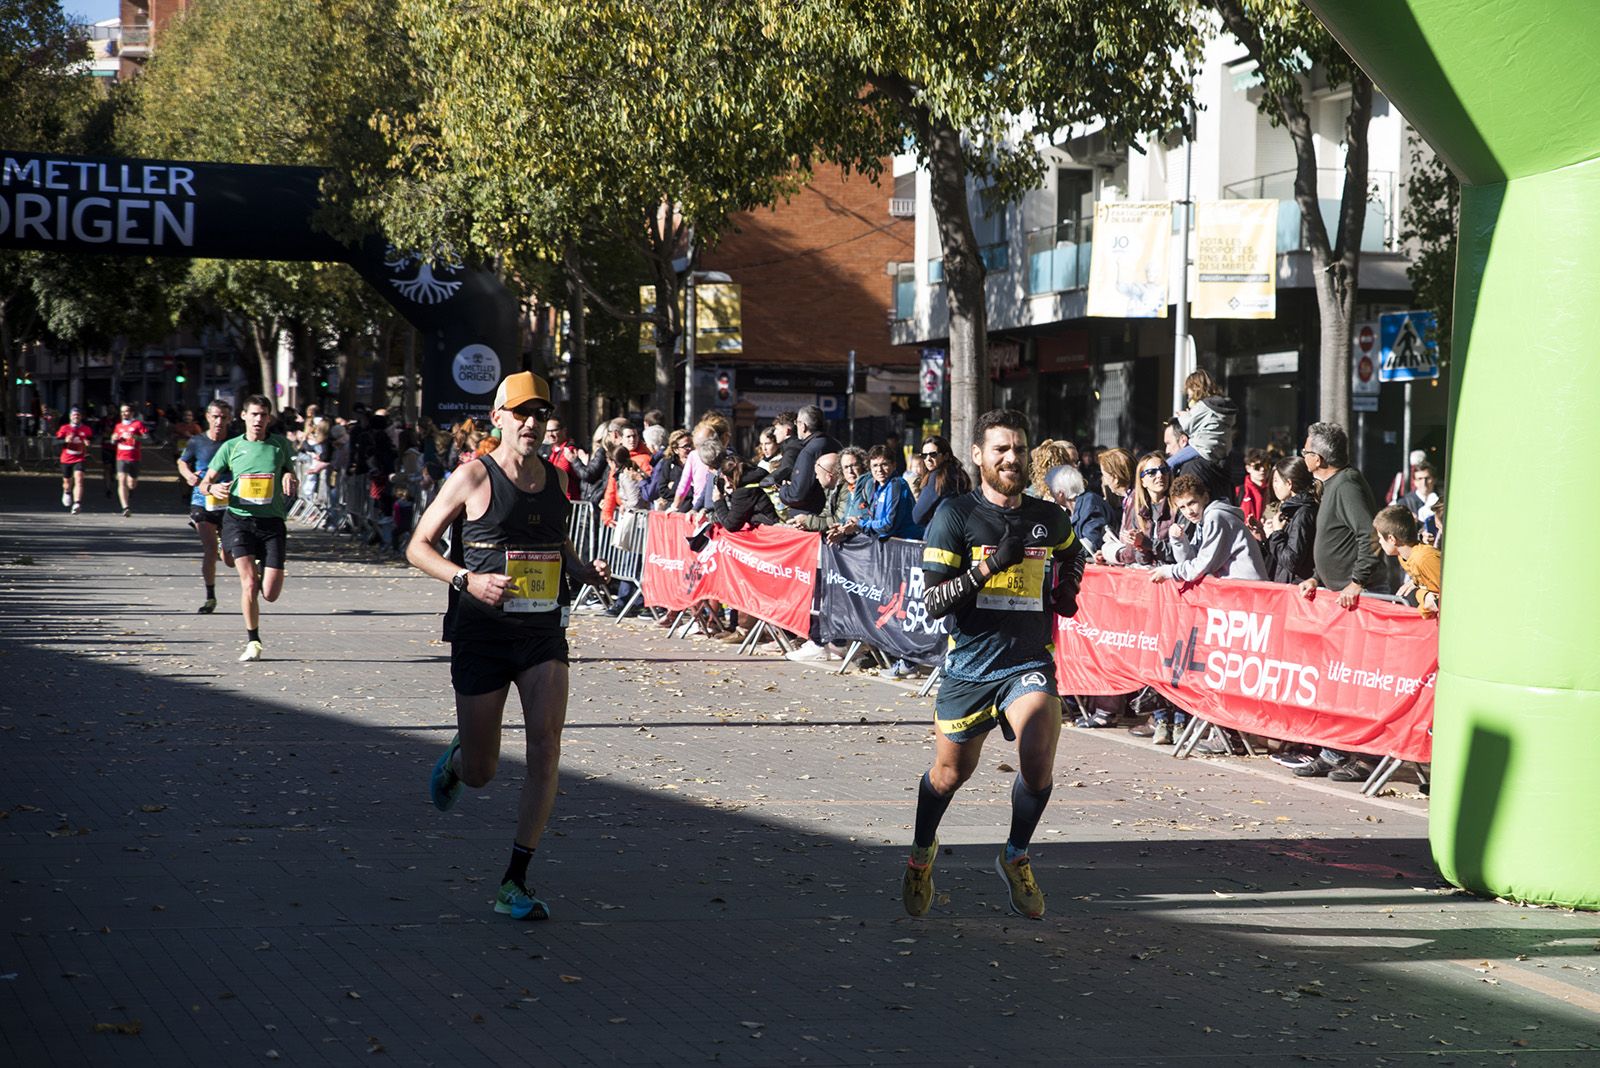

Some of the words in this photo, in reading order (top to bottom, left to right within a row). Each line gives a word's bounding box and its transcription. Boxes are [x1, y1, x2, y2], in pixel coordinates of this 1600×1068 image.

[2, 157, 197, 196] METLLER
[0, 193, 195, 247] RIGEN
[458, 371, 496, 382] ORIGEN
[530, 579, 545, 592] 964
[757, 559, 792, 579] people
[795, 565, 811, 585] feel
[1007, 576, 1024, 589] 955
[1096, 629, 1135, 650] people
[1137, 630, 1160, 652] feel
[1204, 608, 1273, 654] RPM
[1204, 650, 1320, 706] SPORTS
[1327, 660, 1351, 684] We
[1353, 667, 1393, 690] make
